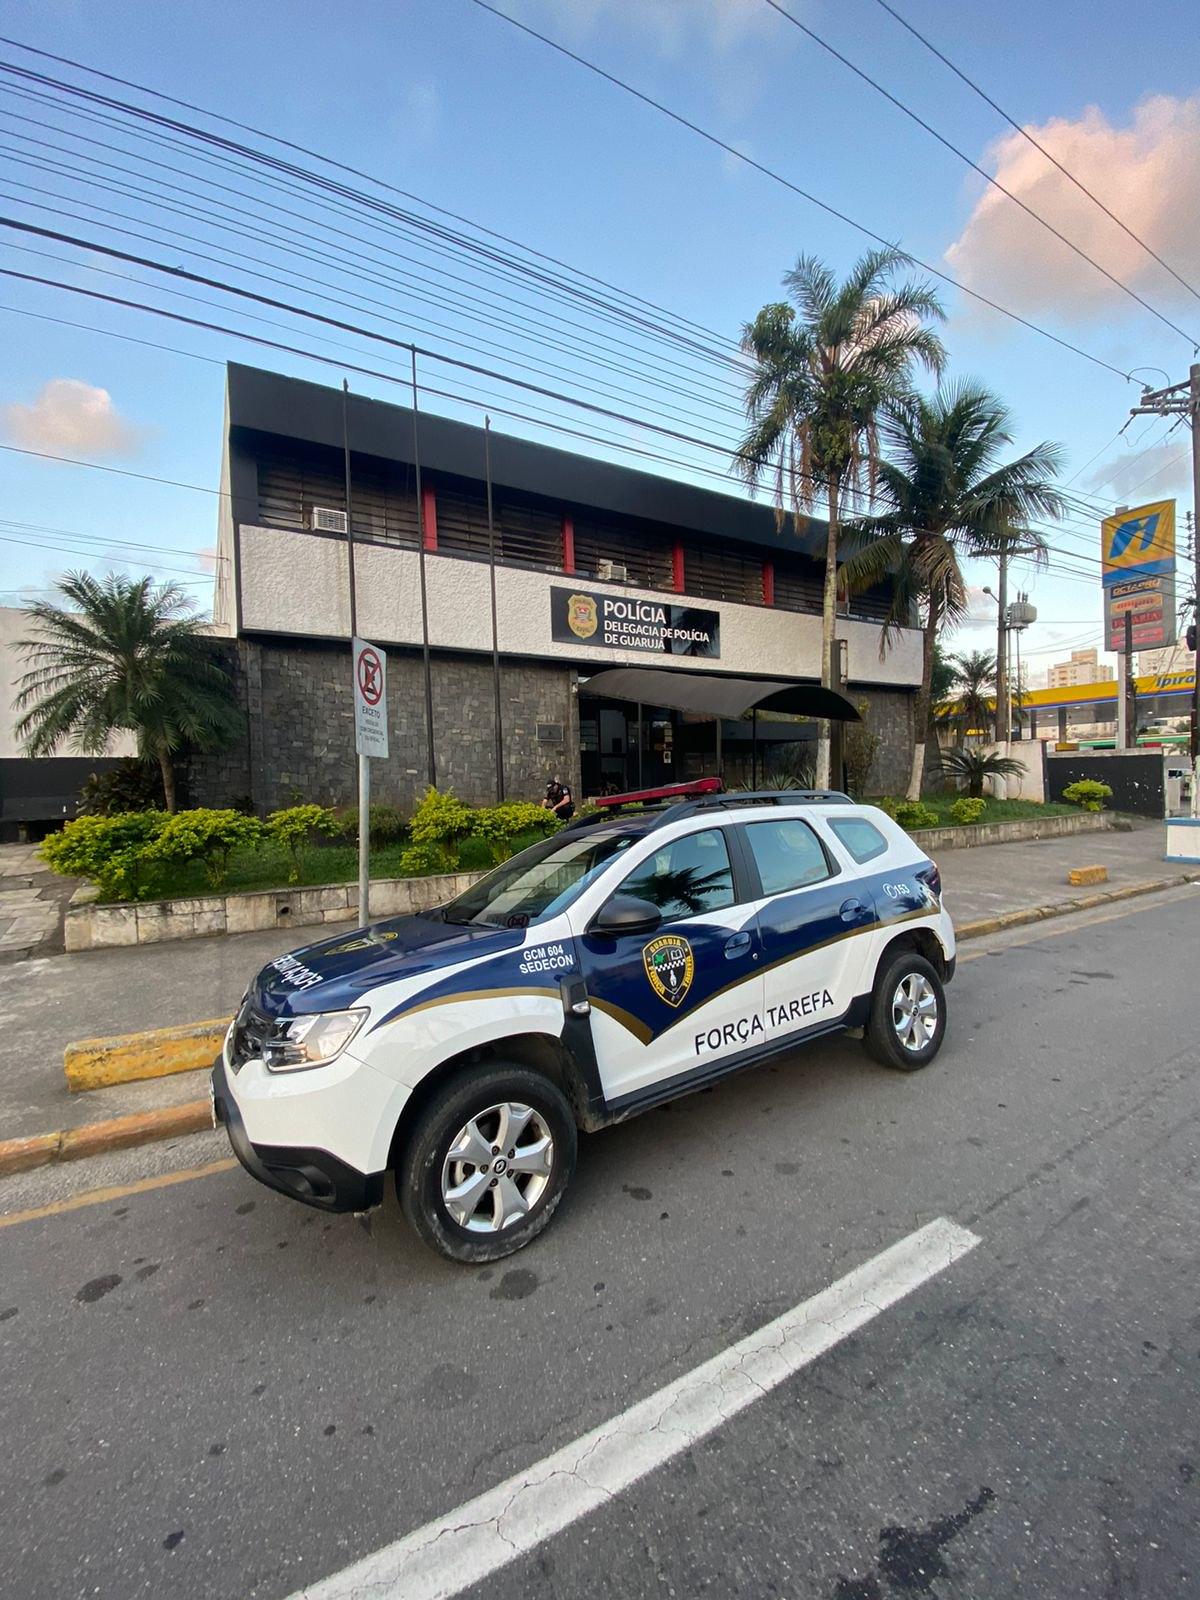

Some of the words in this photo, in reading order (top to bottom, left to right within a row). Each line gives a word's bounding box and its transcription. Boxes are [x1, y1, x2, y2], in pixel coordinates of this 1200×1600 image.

[603, 599, 667, 624] POLÍCIA
[604, 620, 659, 637] DELEGACIA
[660, 628, 673, 638] DE
[674, 629, 710, 642] POLÍCIA
[604, 633, 619, 645] DE
[620, 635, 665, 650] GUARUJÁ
[362, 705, 380, 719] EXCETO
[894, 883, 910, 895] 153
[523, 947, 546, 961] GCM
[548, 944, 564, 957] 604
[519, 954, 574, 974] SEDECON
[694, 1014, 764, 1055] FORÇA
[766, 989, 834, 1027] TAREFA
